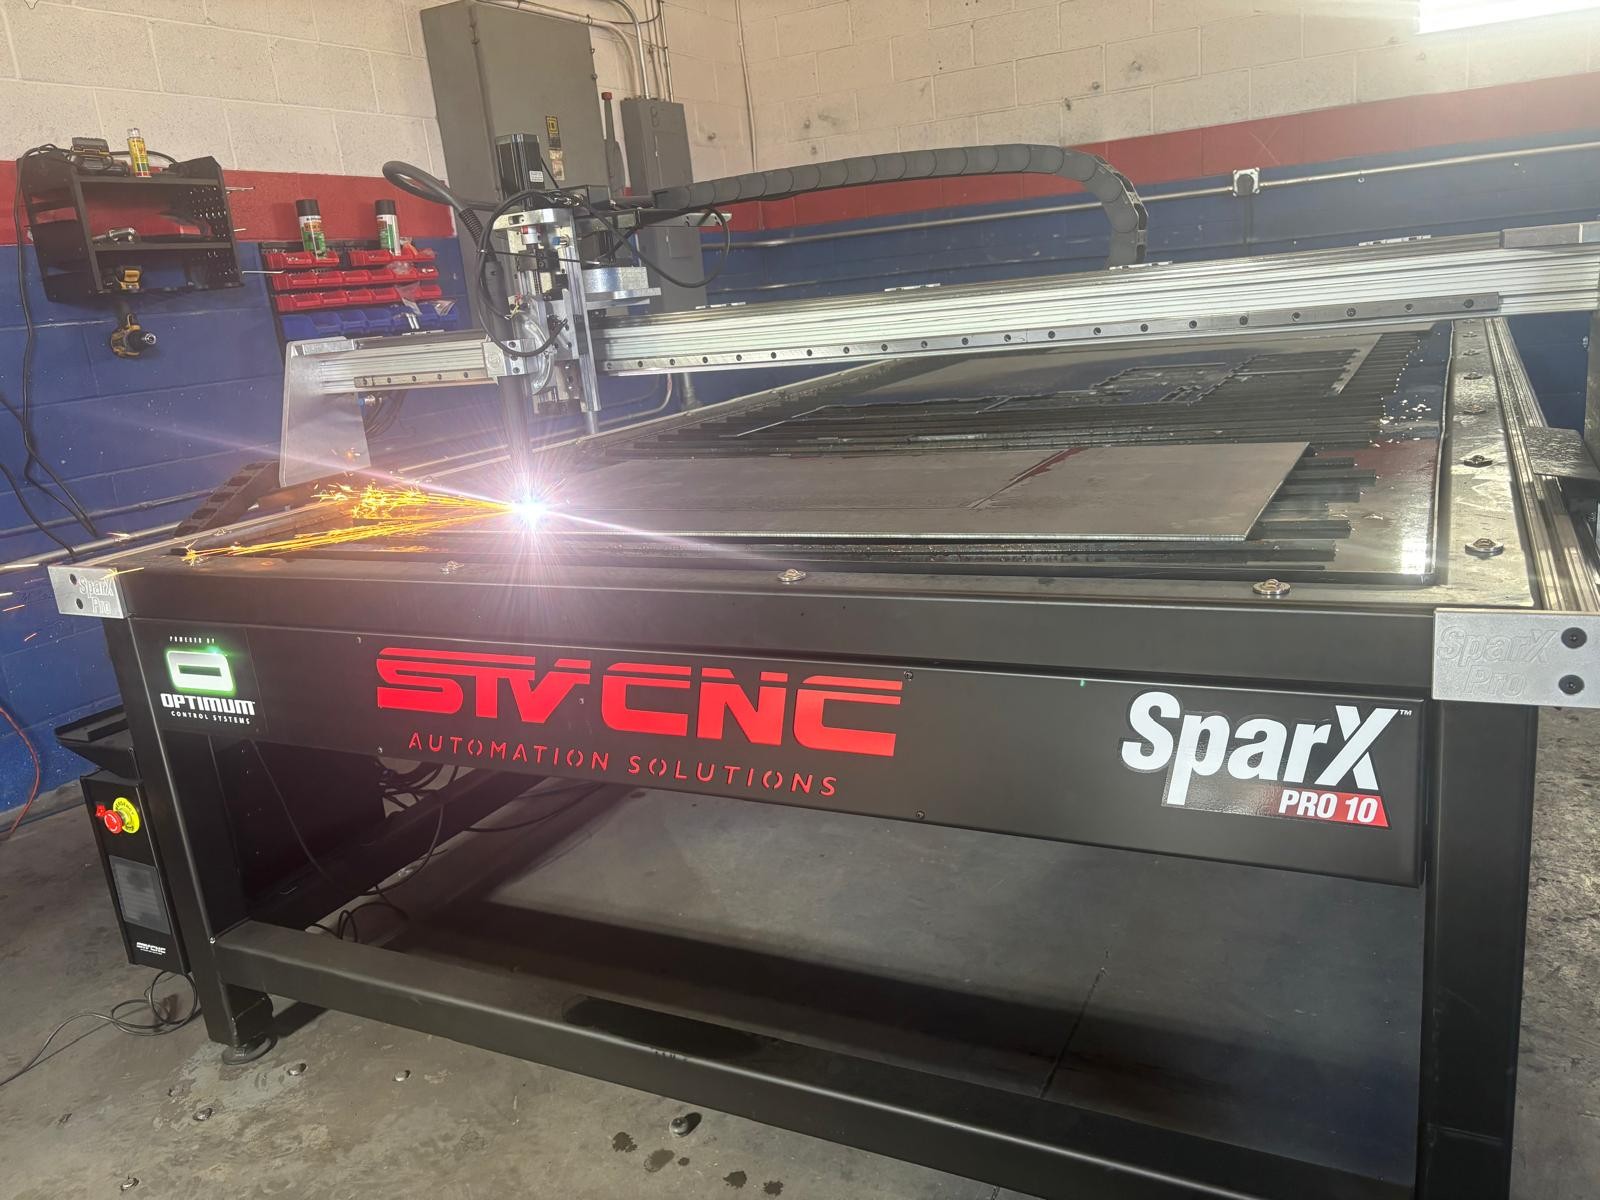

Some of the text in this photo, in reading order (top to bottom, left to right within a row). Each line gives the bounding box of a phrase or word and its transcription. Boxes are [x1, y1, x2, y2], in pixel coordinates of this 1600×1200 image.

[90, 596, 112, 615] Pro
[1436, 626, 1559, 667] SparX
[1463, 664, 1527, 697] Pro
[160, 693, 255, 716] OPTIMUM
[171, 710, 250, 725] CONTROL SYSTEMS
[408, 731, 838, 797] AUTOMATION SOLUTIONS
[1278, 789, 1379, 823] PRO 10
